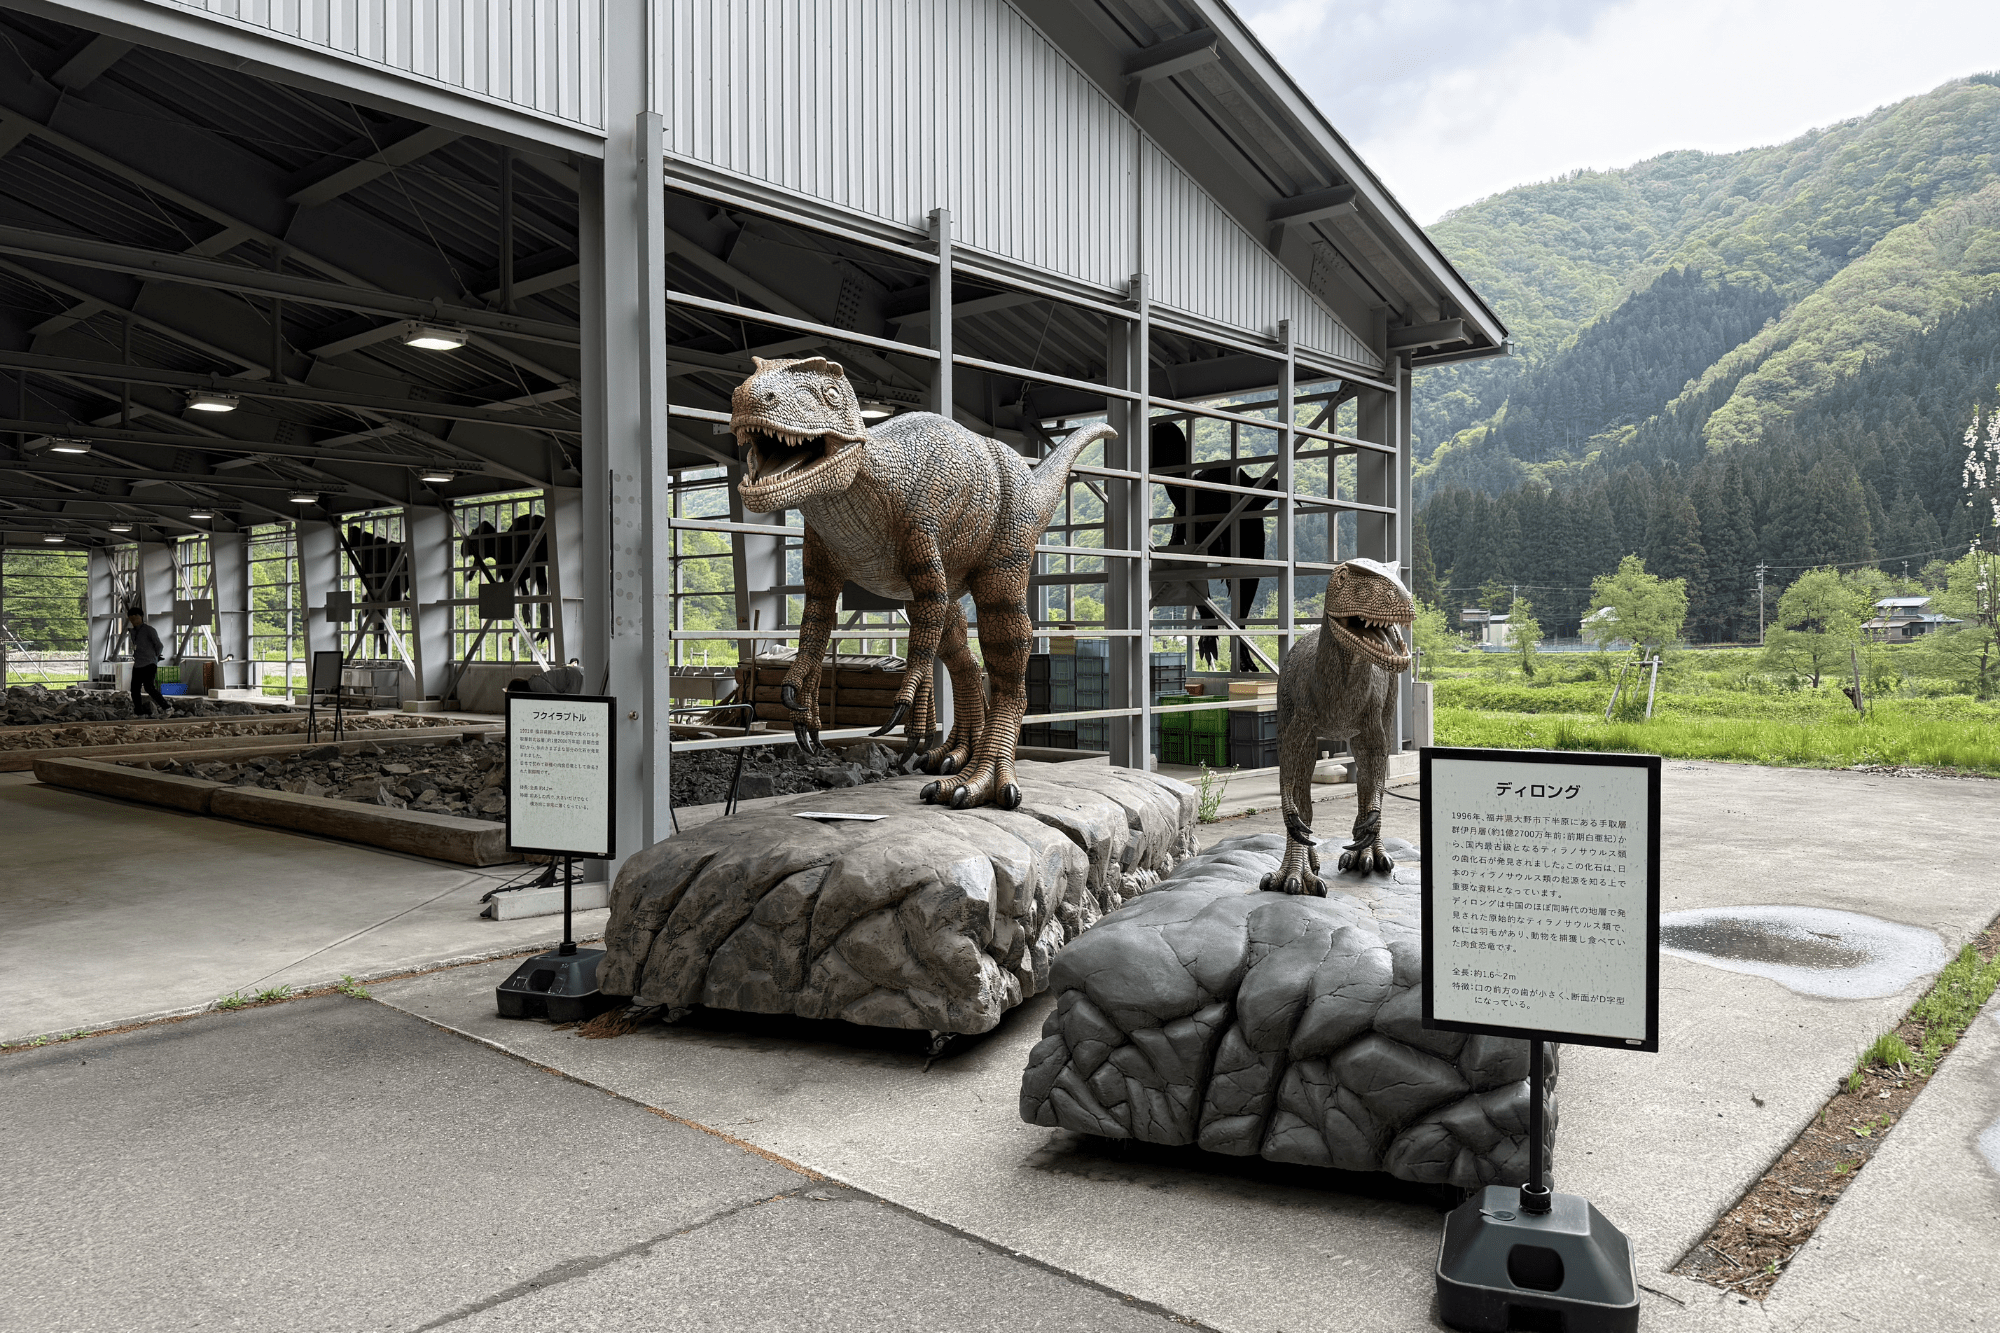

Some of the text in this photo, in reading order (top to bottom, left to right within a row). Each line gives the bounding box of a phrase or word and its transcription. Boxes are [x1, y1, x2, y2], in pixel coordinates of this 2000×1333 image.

[1496, 781, 1581, 800] ディロング
[1452, 812, 1627, 829] 1996年、福井県大野市下半原にある手取層
[1452, 841, 1627, 859] ら、国内最古級となるティラノサウルス類
[1452, 854, 1626, 873] の歯化石が発見されました。この化石は、日
[1452, 869, 1626, 888] 本のティラノサウルス類の起源を知る上で
[1452, 882, 1562, 899] 重要な資料となっています。
[1452, 896, 1626, 918] ディロングは中国のほぼ同時代の地層で発
[1452, 910, 1625, 932] 見された原始的なティラノサウルス類で、
[1452, 925, 1626, 946] 体には羽毛があり、動物を捕獲し食べてい
[1452, 939, 1517, 953] た肉食恐竜です。
[1474, 996, 1531, 1010] になっている。
